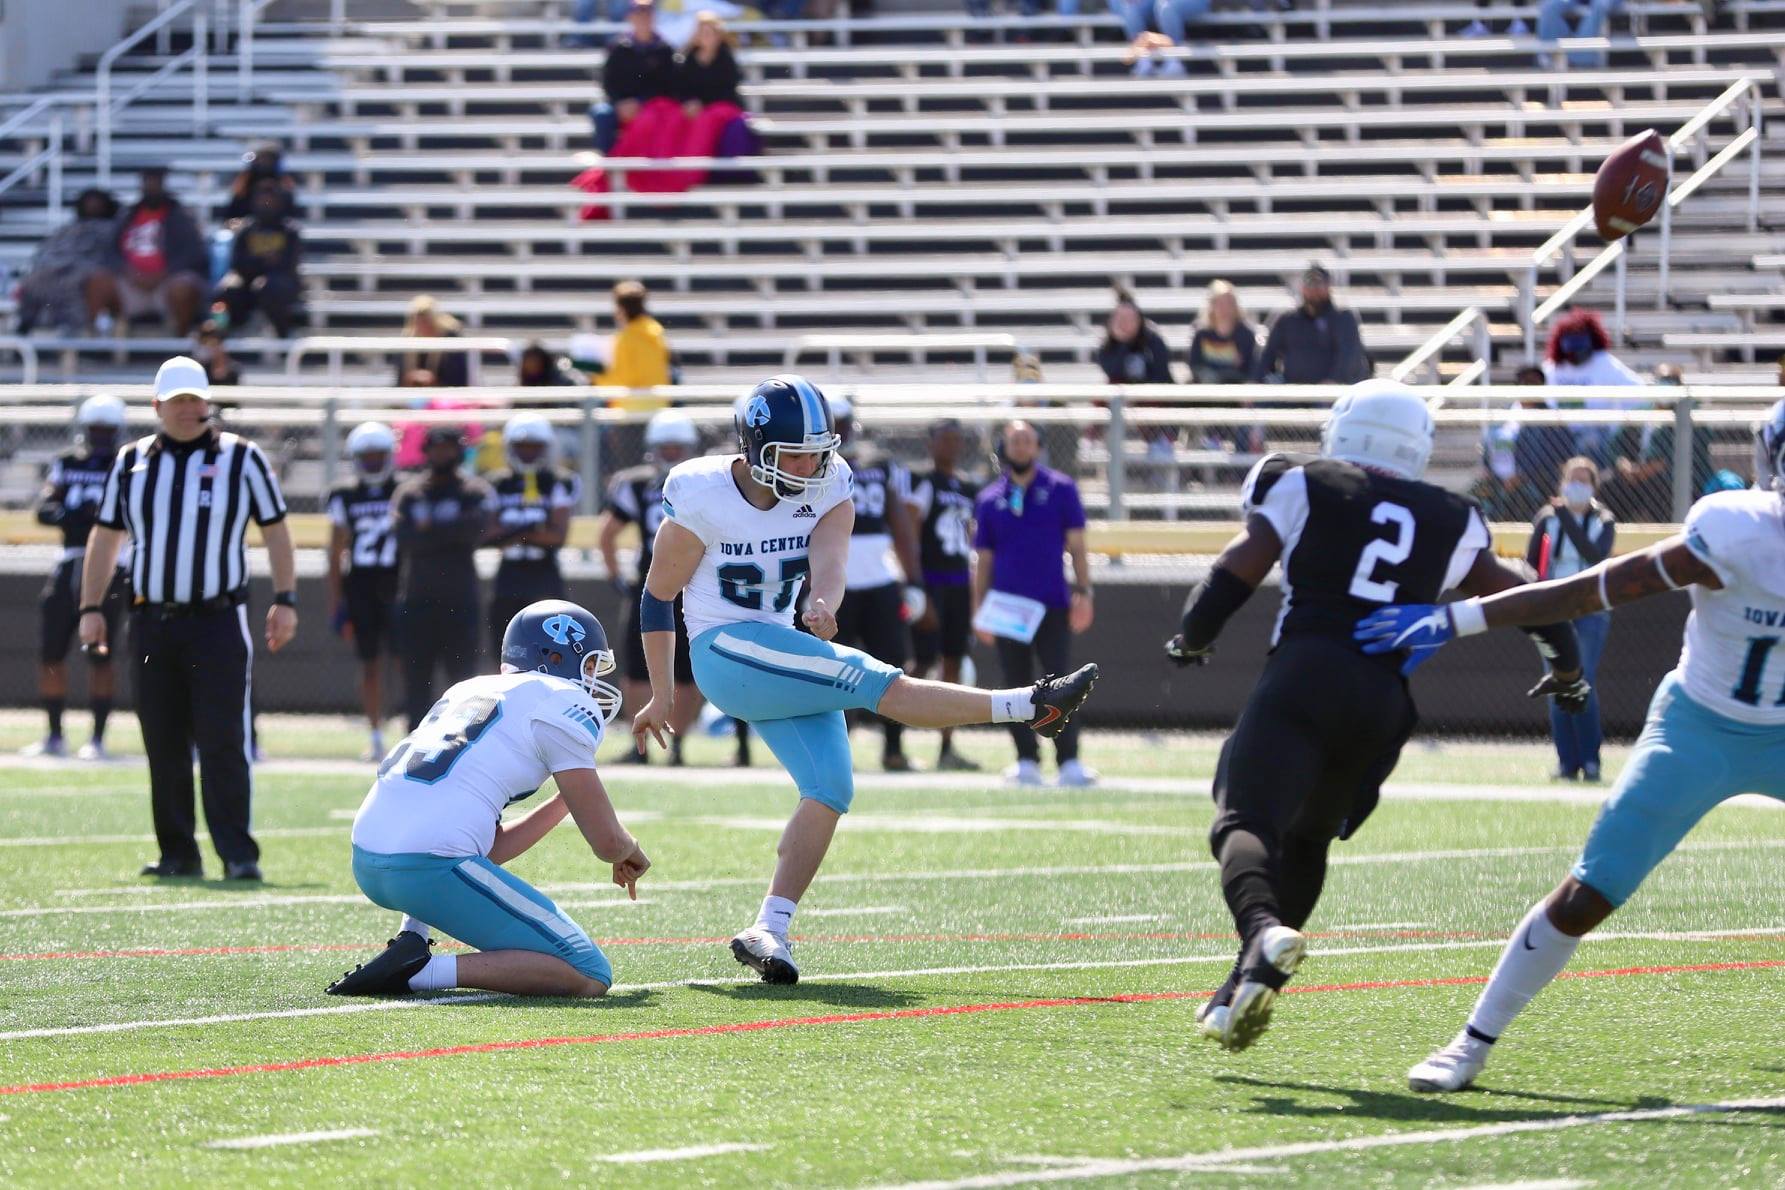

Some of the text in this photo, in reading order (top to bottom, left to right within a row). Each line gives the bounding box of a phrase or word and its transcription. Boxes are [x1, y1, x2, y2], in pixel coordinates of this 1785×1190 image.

[792, 511, 817, 519] adidas
[720, 541, 754, 557] IOWA
[1347, 501, 1416, 603] 2
[716, 556, 810, 613] 27
